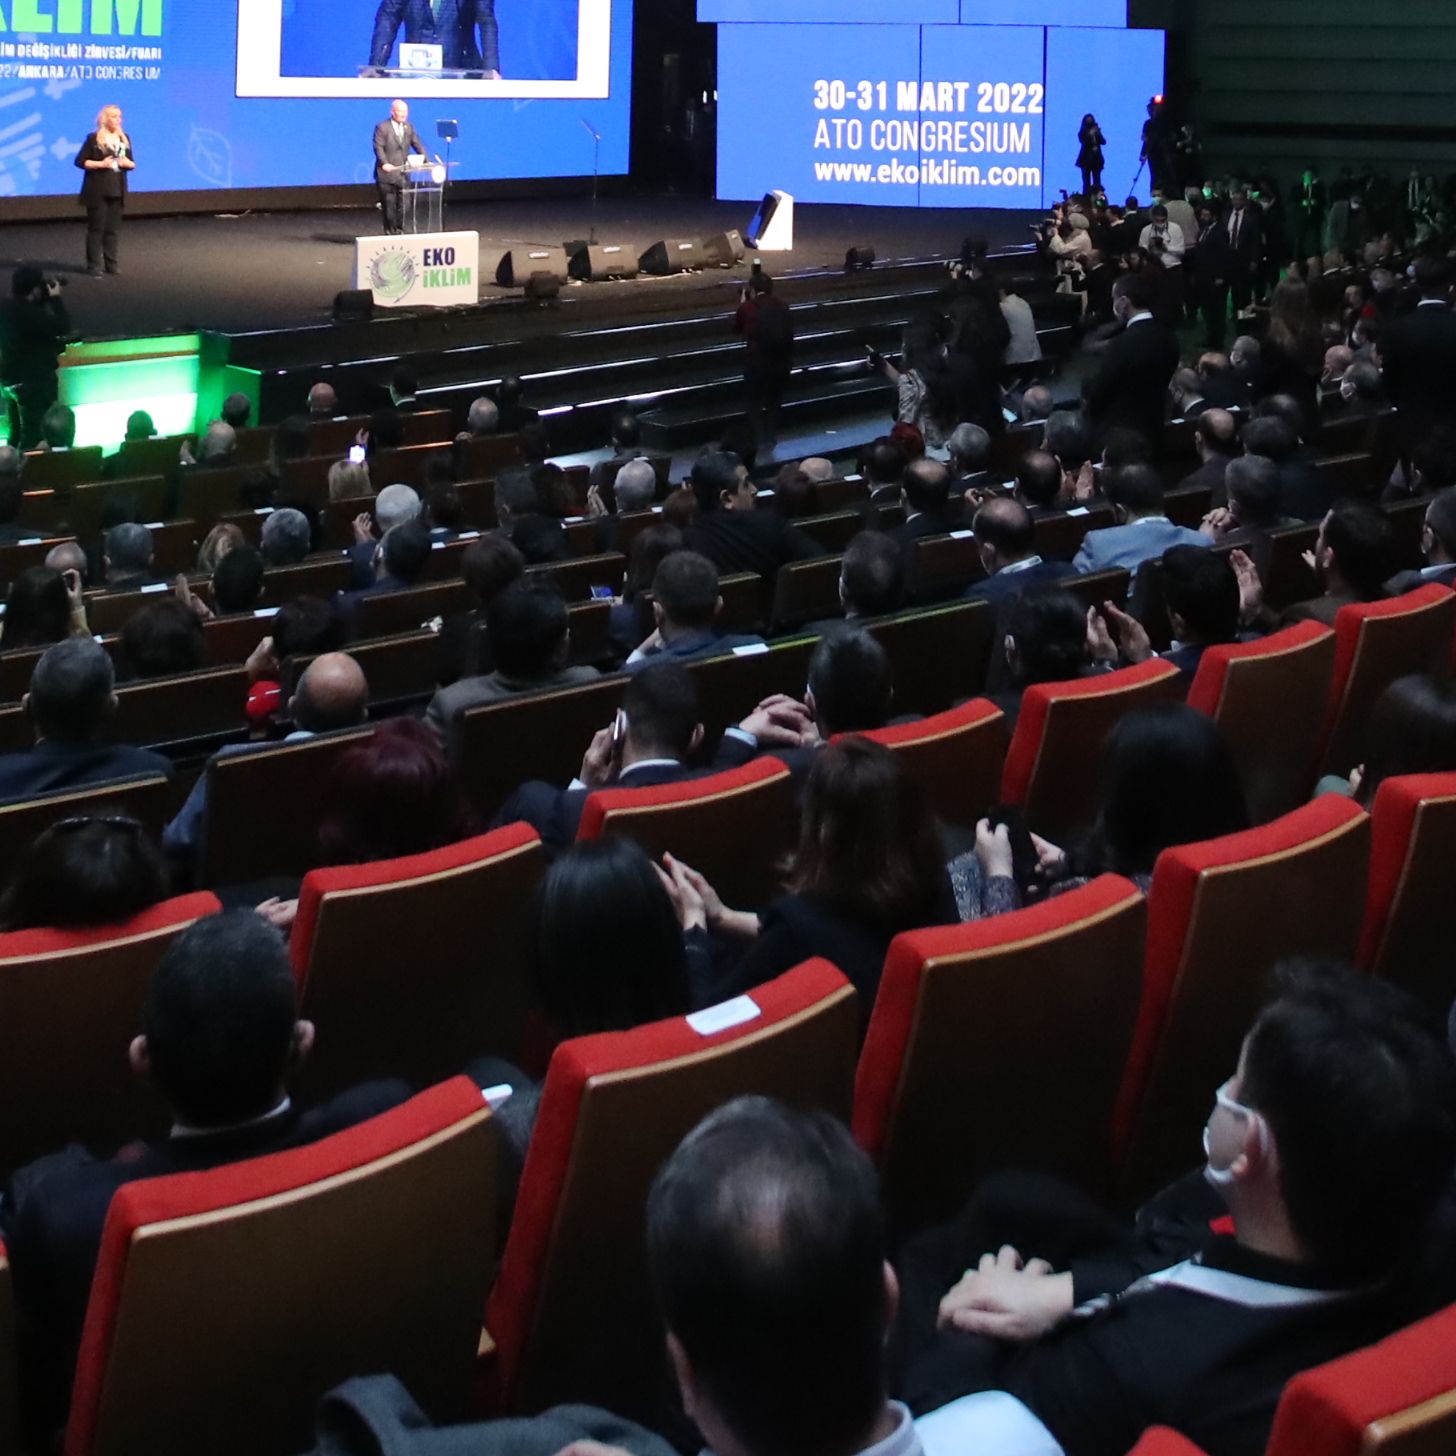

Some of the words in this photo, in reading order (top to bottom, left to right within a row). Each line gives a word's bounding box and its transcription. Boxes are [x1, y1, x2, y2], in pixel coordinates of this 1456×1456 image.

[813, 79, 888, 111] 30-31
[896, 81, 971, 112] MART
[976, 82, 1044, 113] 2022
[813, 118, 863, 150] ATO
[870, 119, 1031, 153] CONGRESIUM
[814, 157, 1041, 186] www.ekoiklim.com
[423, 246, 456, 267] EKO
